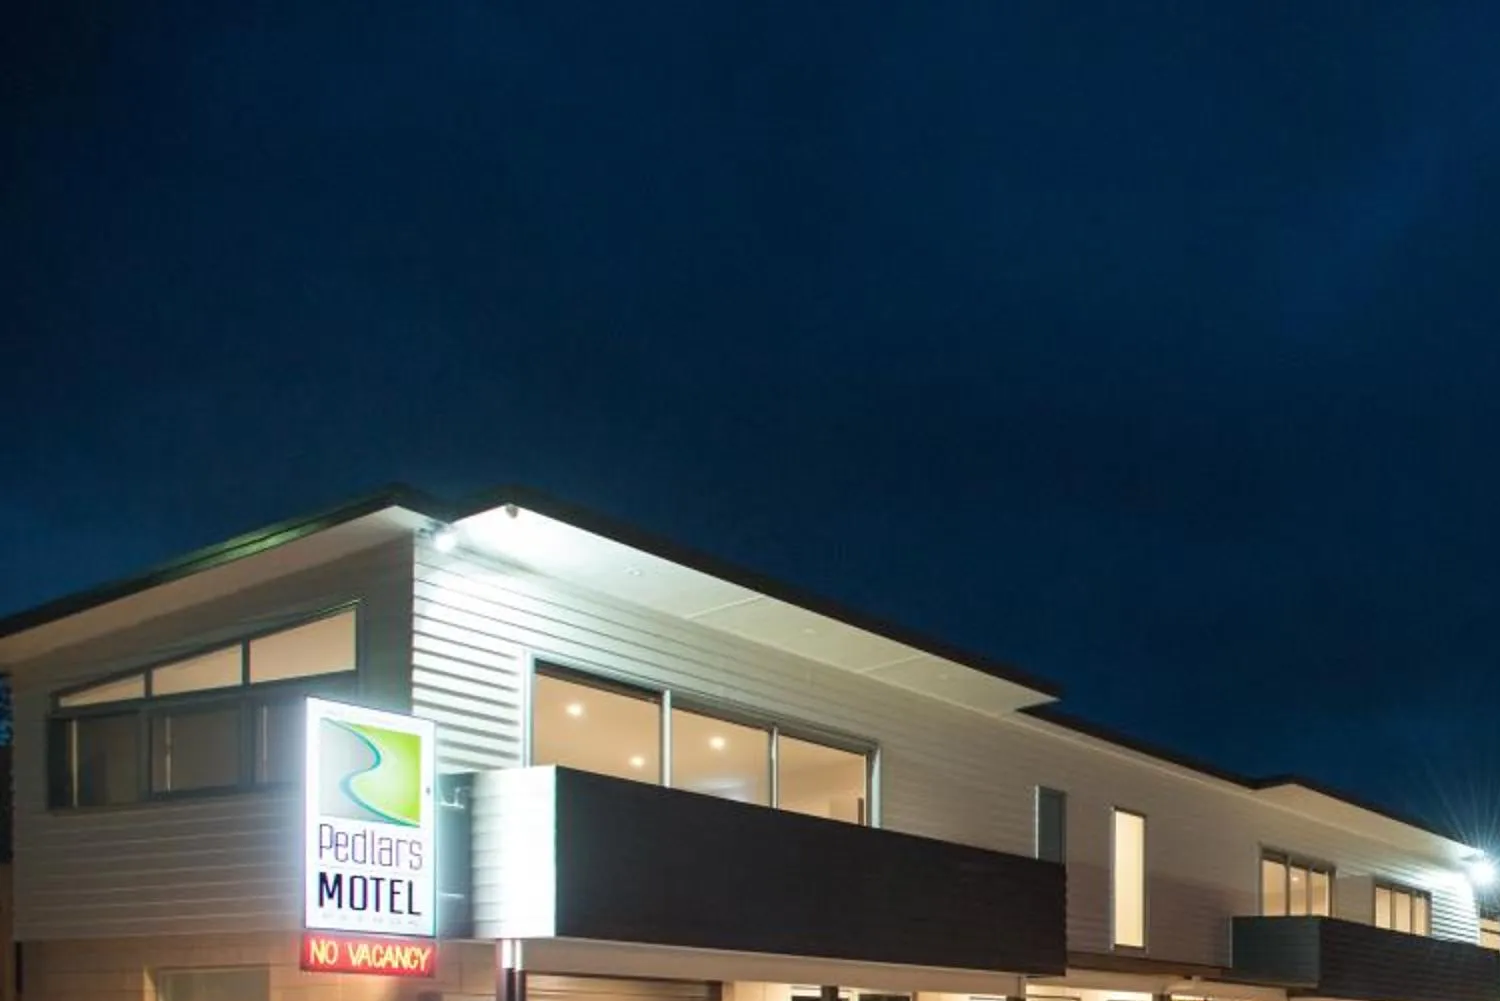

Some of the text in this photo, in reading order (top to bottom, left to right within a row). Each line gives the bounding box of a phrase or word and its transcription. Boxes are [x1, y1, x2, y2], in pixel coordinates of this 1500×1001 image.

[319, 824, 422, 870] Pedlars
[318, 872, 421, 915] MOTEL
[309, 939, 432, 971] NO VACANCY
